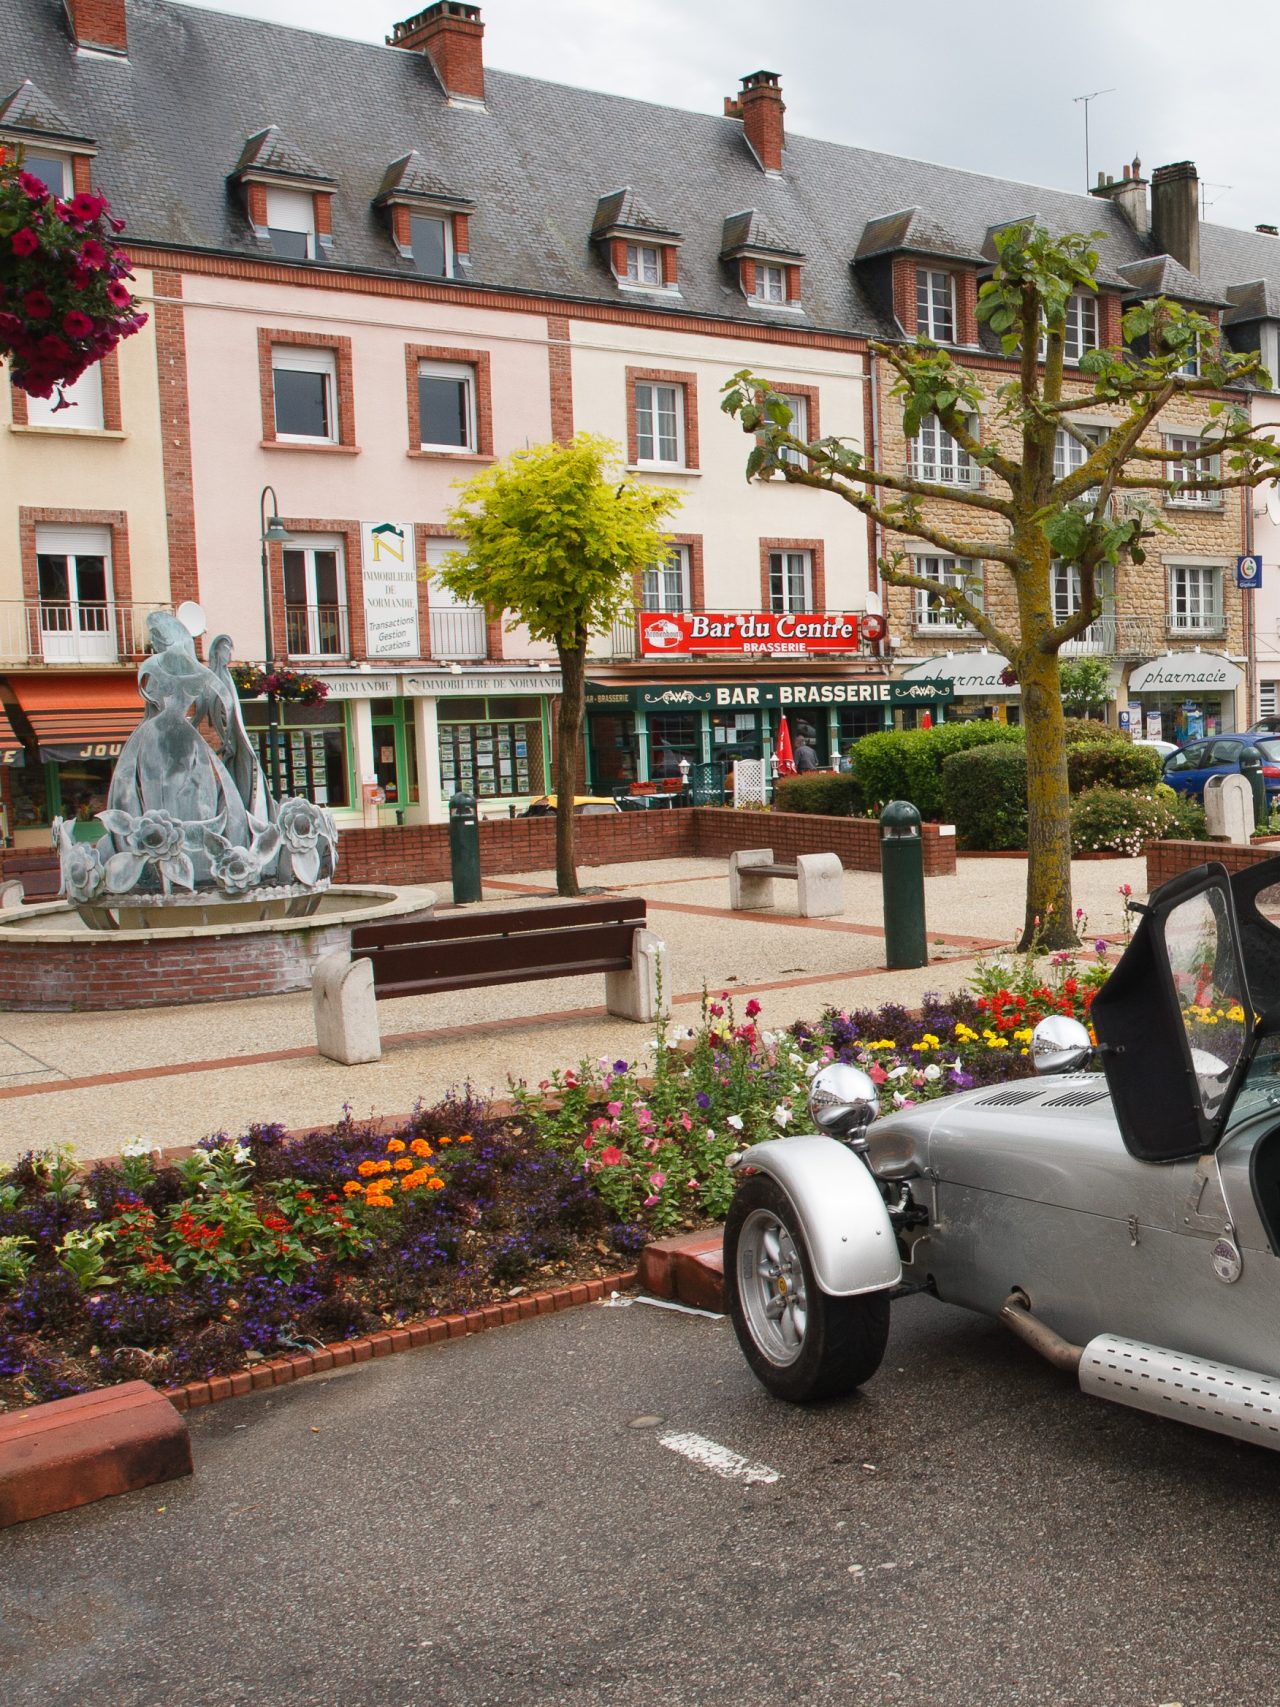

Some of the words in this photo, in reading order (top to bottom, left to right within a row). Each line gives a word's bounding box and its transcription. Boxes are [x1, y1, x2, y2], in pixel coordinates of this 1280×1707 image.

[364, 571, 415, 581] IMMOBILIERE
[385, 584, 396, 595] DE
[367, 598, 414, 609] NORMANDIE
[369, 616, 414, 631] Transactions
[690, 616, 734, 638] Bar
[740, 616, 770, 638] du
[776, 617, 853, 638] Centre
[378, 629, 407, 642] Gestion
[375, 640, 411, 653] Locations
[743, 642, 806, 652] BRASSERIE
[422, 679, 490, 690] IMMOBILIERE
[493, 679, 506, 688] DE
[508, 678, 561, 688] NORMANDI
[1139, 667, 1226, 690] pharmacie
[716, 687, 760, 705] BAR
[779, 684, 891, 704] BRASSERIE
